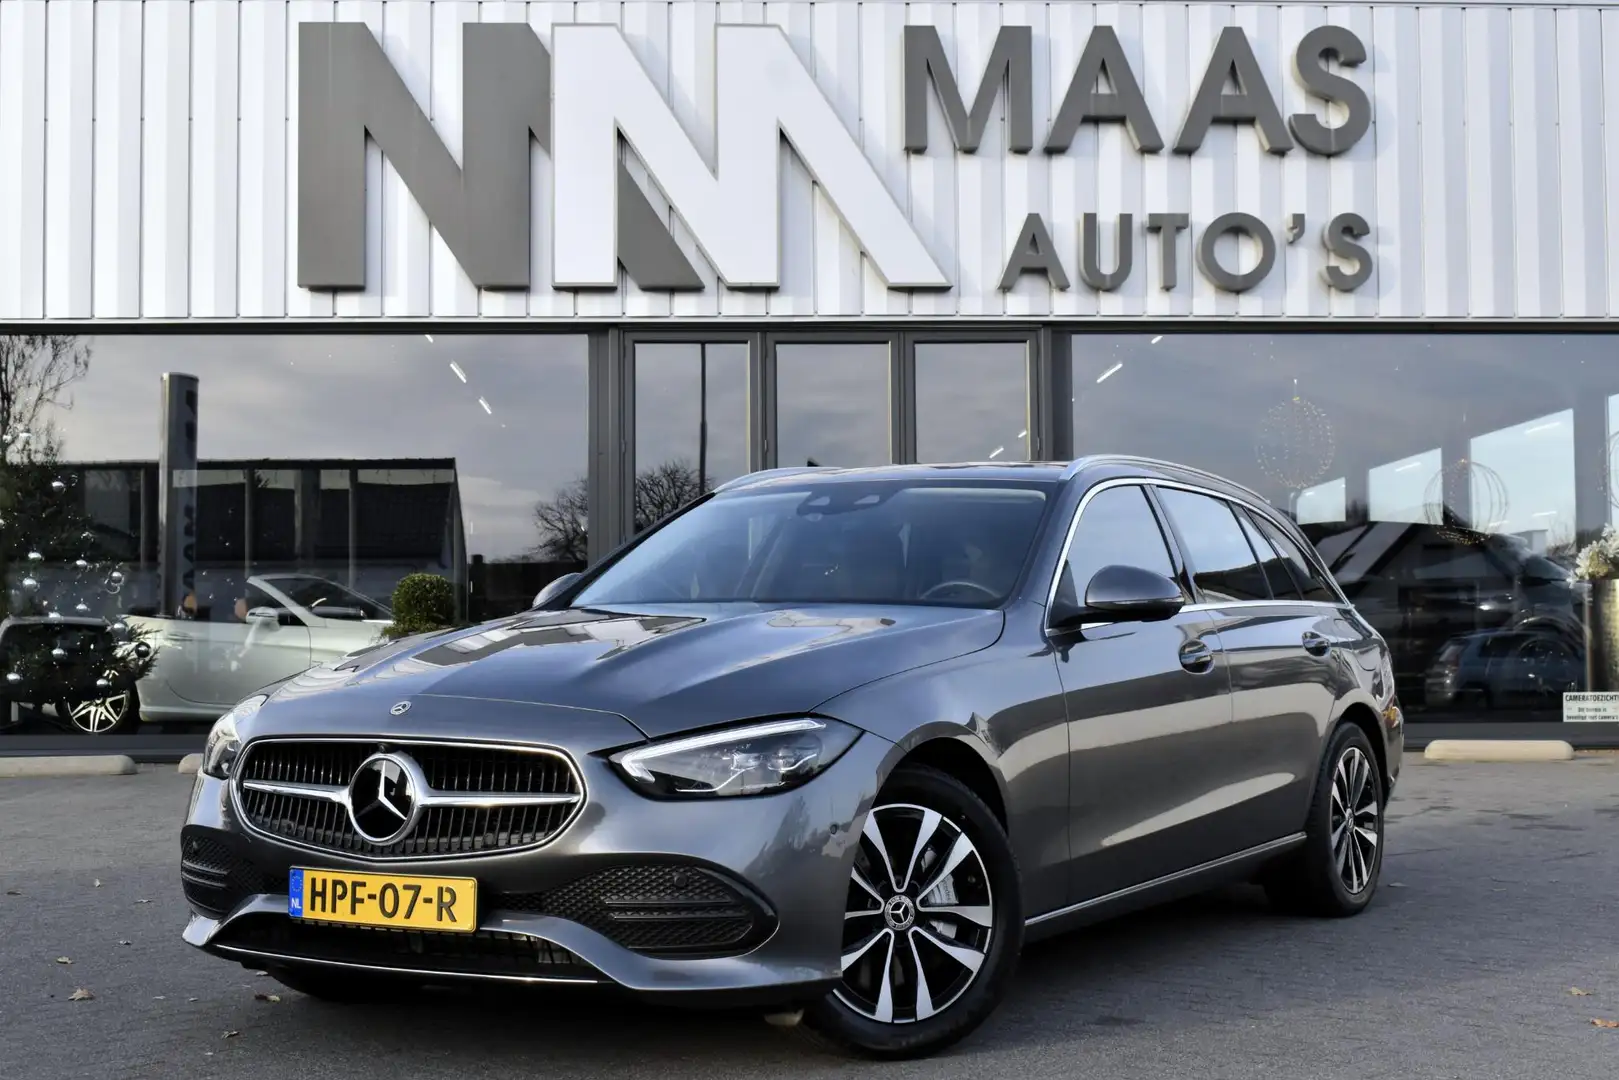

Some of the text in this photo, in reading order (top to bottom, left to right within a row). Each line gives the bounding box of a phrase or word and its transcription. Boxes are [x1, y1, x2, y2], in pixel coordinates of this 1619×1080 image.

[904, 25, 1372, 156] MAAS
[997, 211, 1374, 292] AUTO'S
[291, 877, 458, 922] NL HPF-07-R
